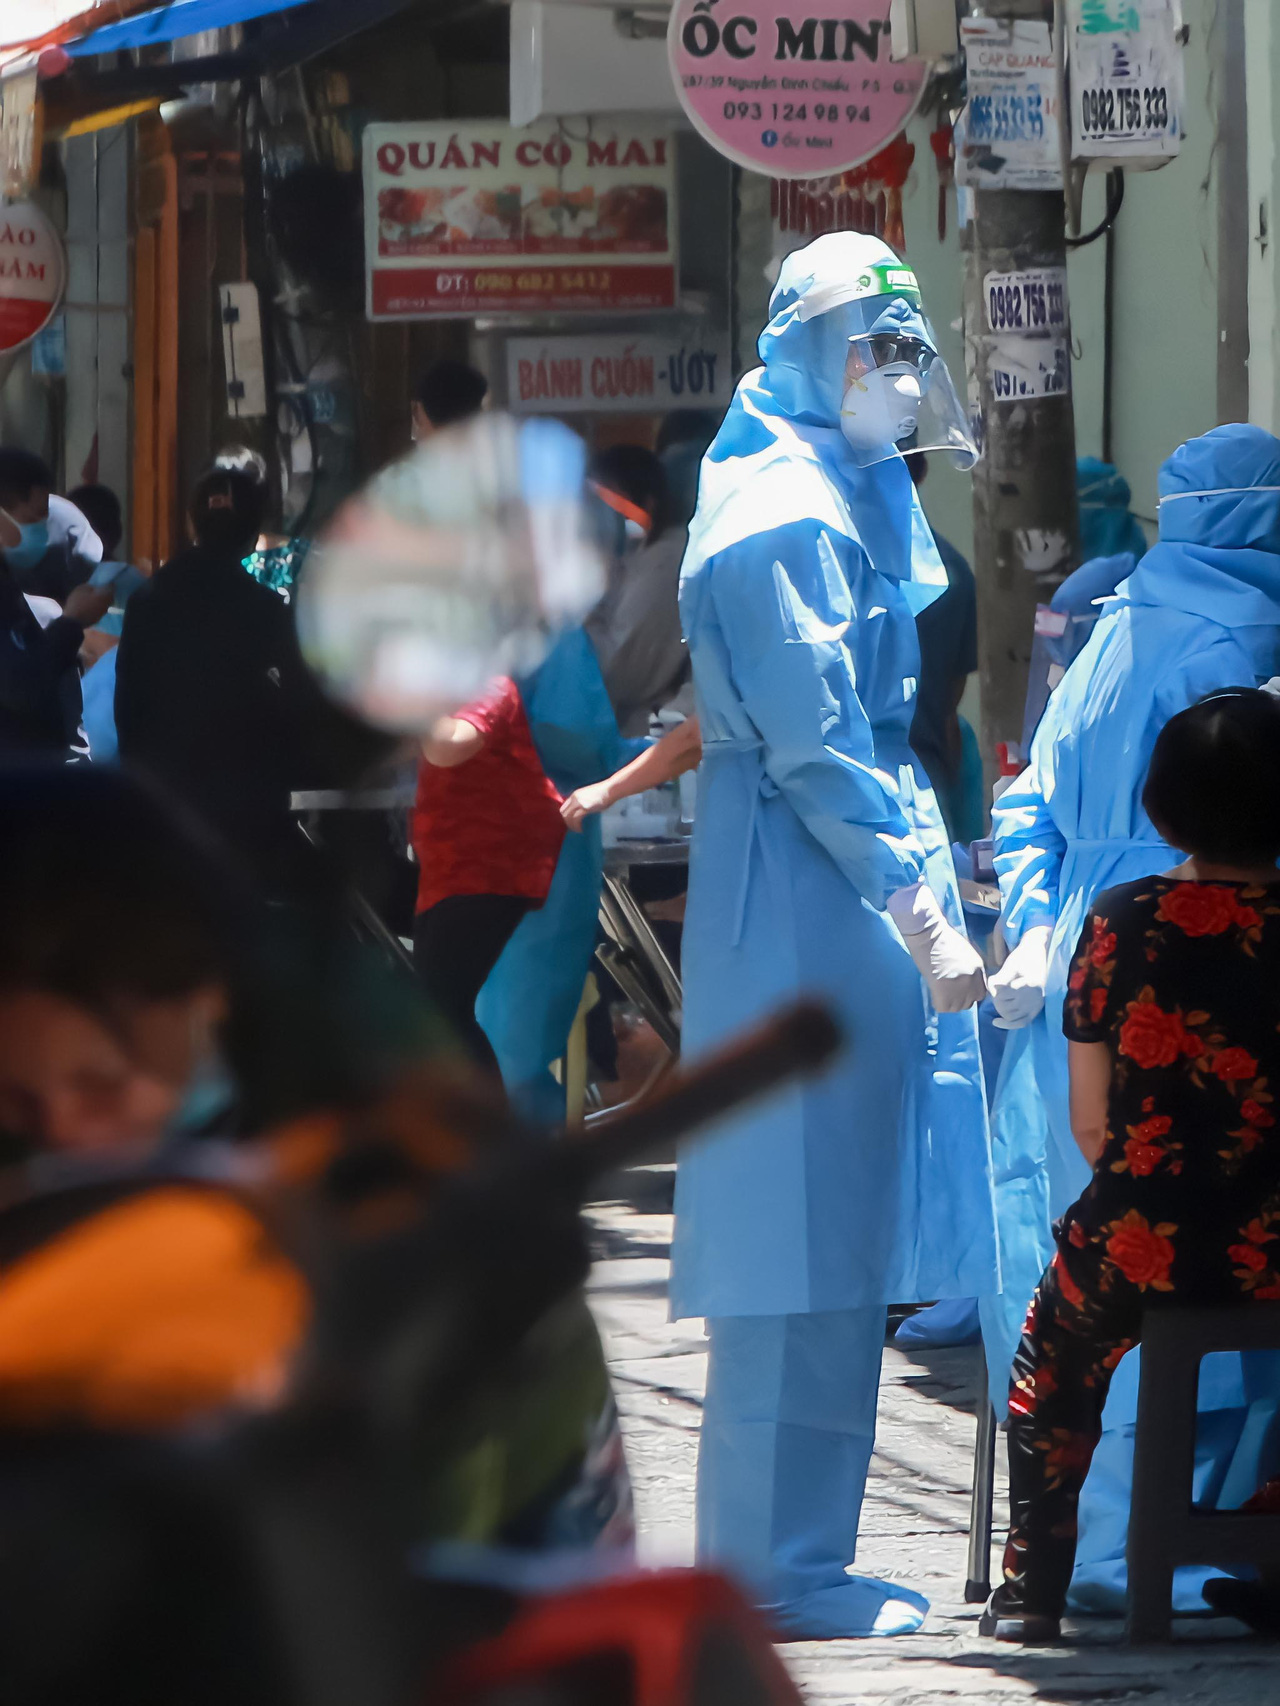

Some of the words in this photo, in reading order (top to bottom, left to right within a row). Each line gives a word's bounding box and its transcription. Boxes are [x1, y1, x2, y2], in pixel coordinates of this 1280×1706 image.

[682, 0, 757, 59] ỐC
[723, 102, 762, 121] 093
[772, 103, 807, 121] 124
[814, 105, 839, 122] 98
[846, 105, 871, 123] 94
[377, 134, 501, 176] QUÁN
[515, 133, 571, 168] CÔ
[586, 138, 667, 168] MAI
[518, 350, 583, 400] BÁNH
